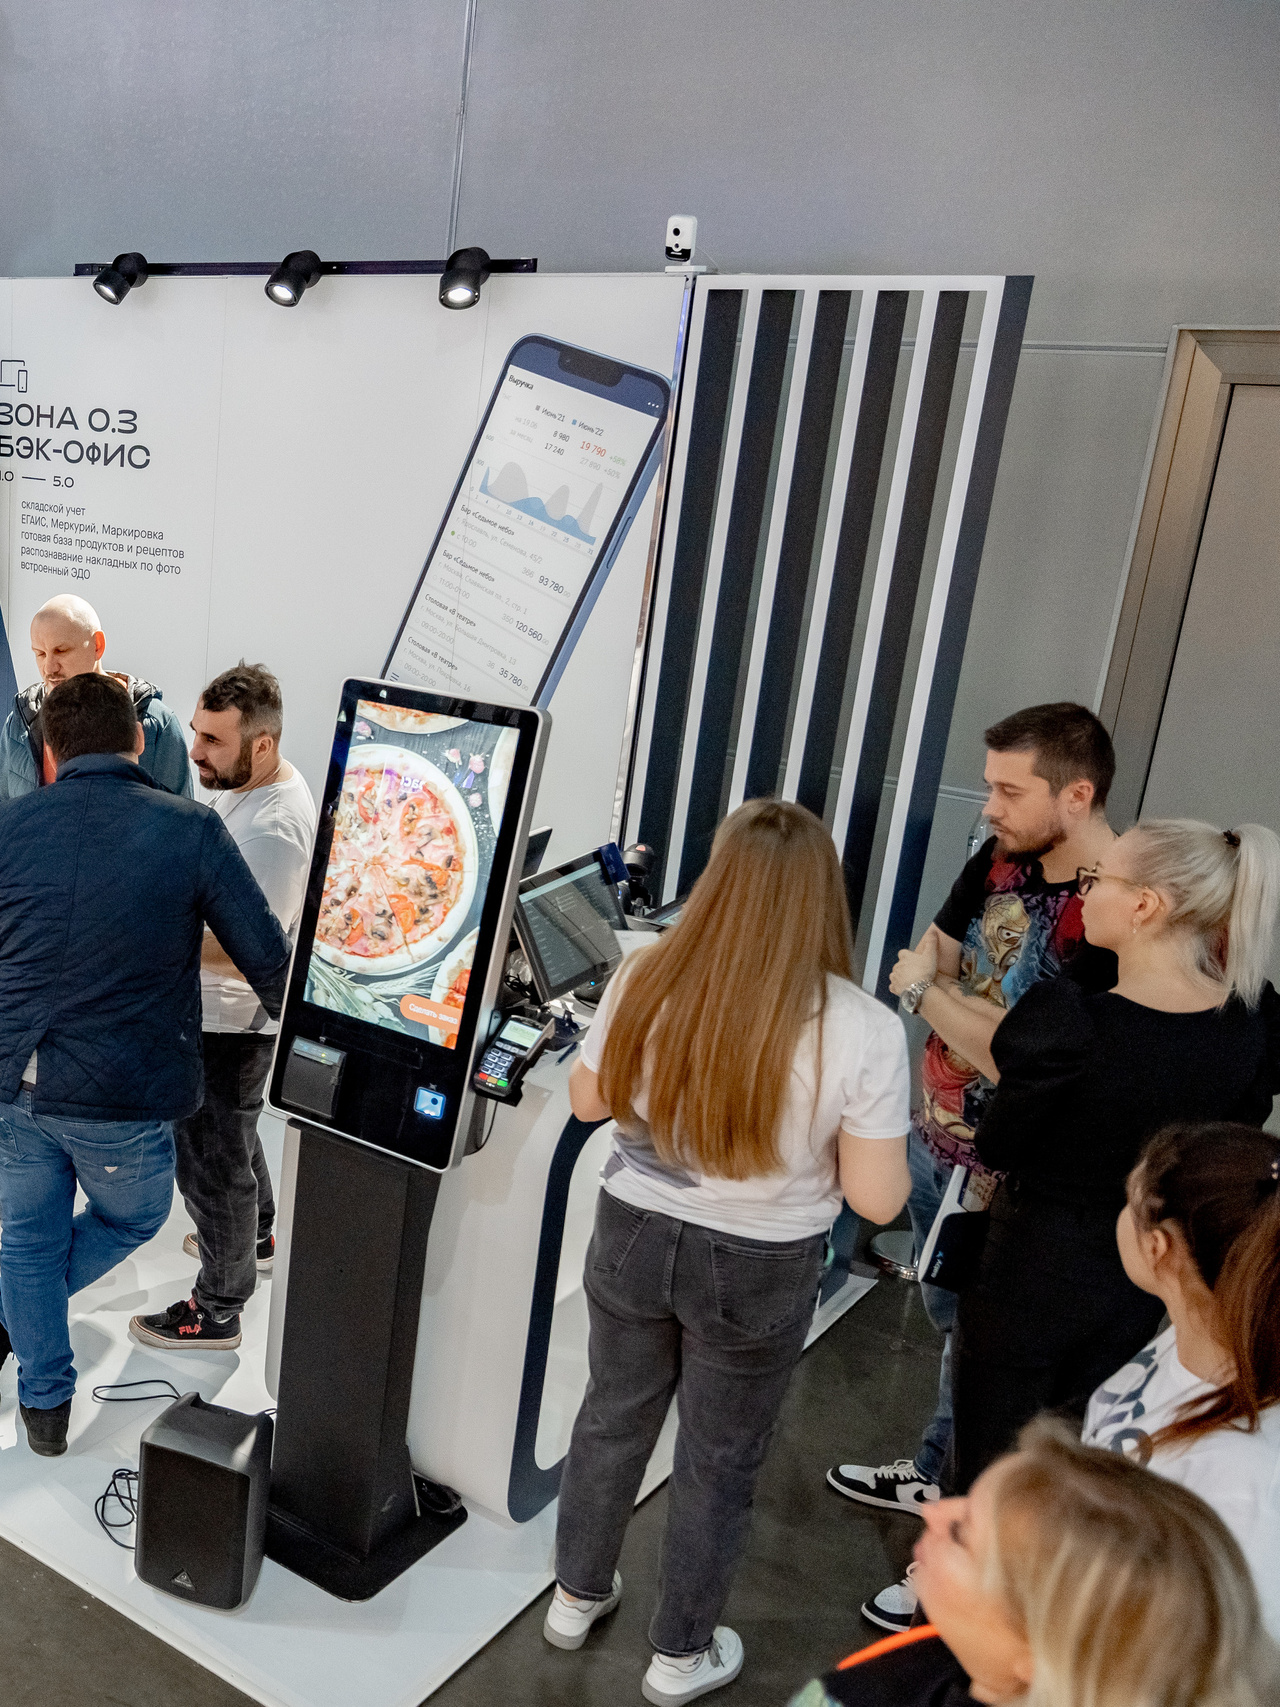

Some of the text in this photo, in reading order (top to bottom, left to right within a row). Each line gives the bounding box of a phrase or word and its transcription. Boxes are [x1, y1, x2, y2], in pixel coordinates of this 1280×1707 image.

[508, 374, 534, 391] Выручка
[88, 407, 138, 434] 0.3
[53, 475, 74, 488] 5.0
[21, 500, 86, 516] складской учет
[460, 504, 471, 516] Бар
[21, 514, 164, 540] ЕГАИС, Меркурий, Маркировка
[21, 531, 184, 559] готовая база продуктов и рецептов
[20, 546, 181, 575] распознавание накладных по фото
[442, 550, 453, 560] Бар
[20, 560, 91, 580] встроенный ЭДО
[538, 575, 549, 587] 93
[424, 593, 449, 611] Столовая
[514, 620, 527, 633] 120
[407, 636, 431, 654] Столовая
[498, 667, 509, 678] 35
[179, 1324, 202, 1335] FILA
